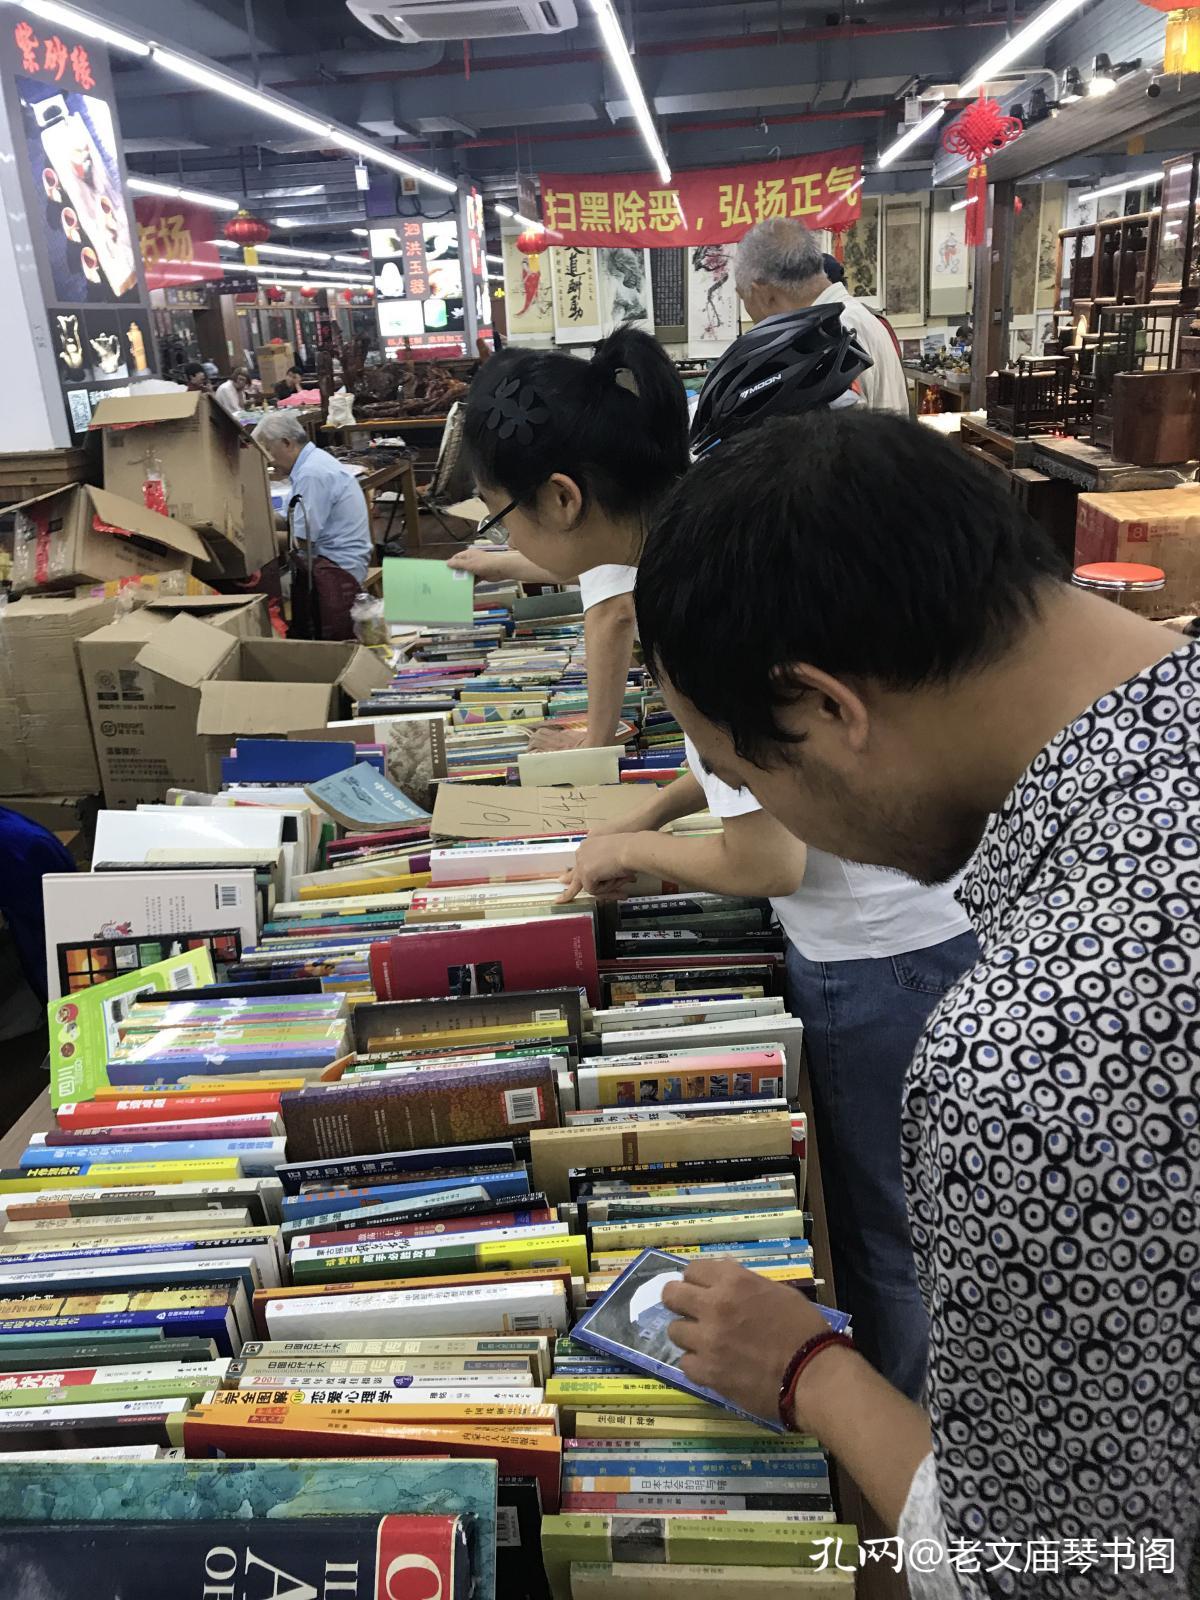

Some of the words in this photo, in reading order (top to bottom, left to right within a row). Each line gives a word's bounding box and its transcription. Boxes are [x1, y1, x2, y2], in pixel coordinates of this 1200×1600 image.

[404, 222, 426, 295] 泗洪玉器
[749, 373, 782, 394] MOON
[311, 1389, 392, 1403] 恋爱心理学
[641, 1479, 728, 1490] 日本社会的明与暗
